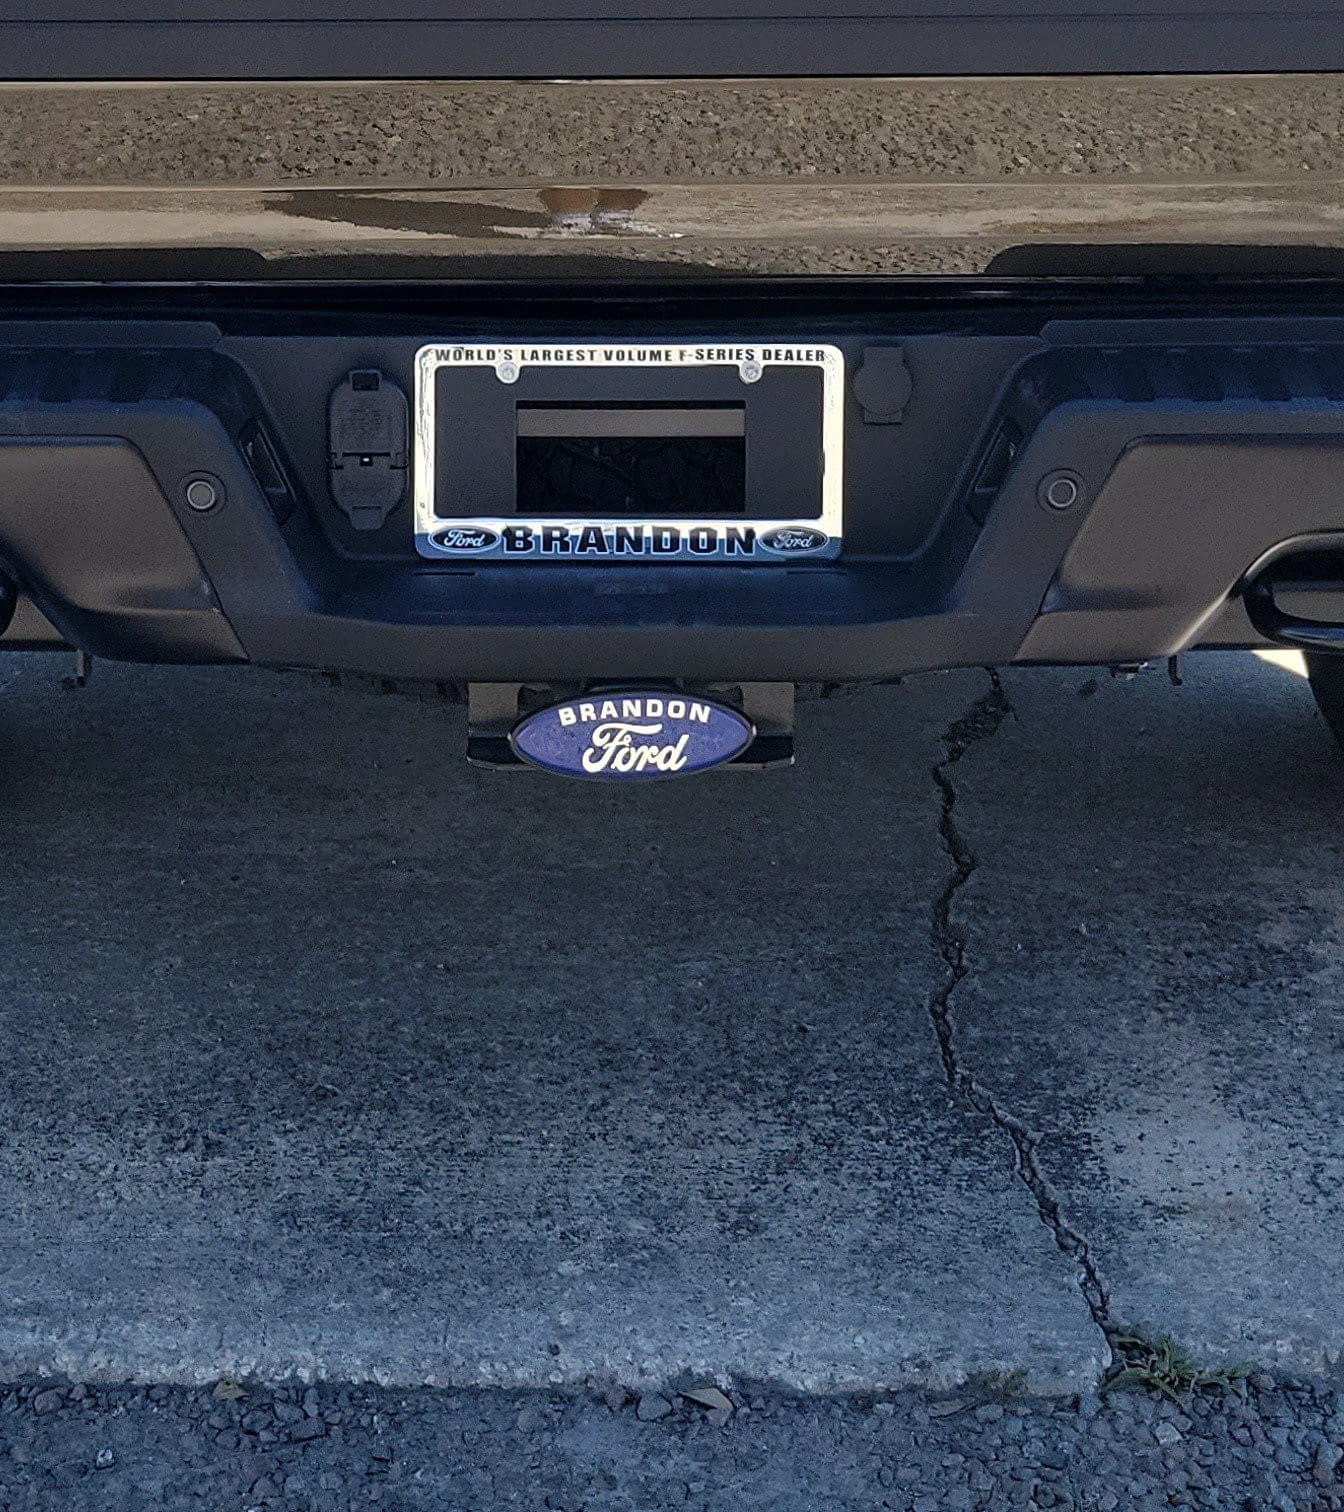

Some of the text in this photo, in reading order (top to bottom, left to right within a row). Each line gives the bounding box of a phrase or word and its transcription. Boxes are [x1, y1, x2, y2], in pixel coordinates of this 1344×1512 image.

[435, 348, 825, 362] WORLD'S LARGEST VOLUME F-SERIES DEALER
[443, 524, 813, 555] Ford BRANDON Ford
[558, 699, 711, 726] BRANDON
[582, 722, 690, 773] Ford
